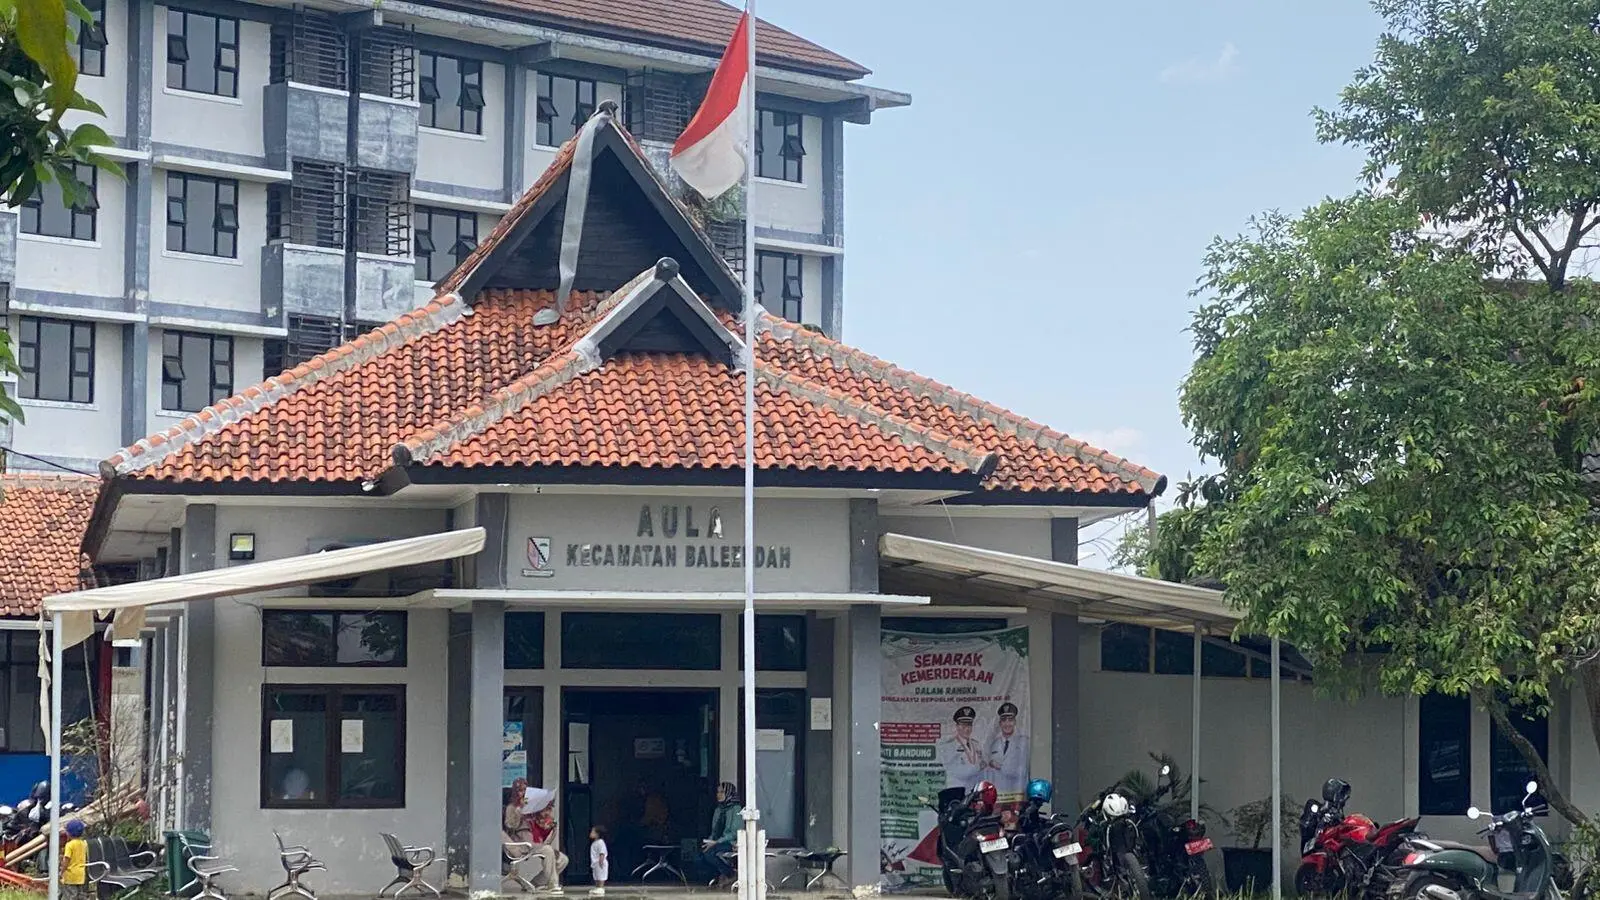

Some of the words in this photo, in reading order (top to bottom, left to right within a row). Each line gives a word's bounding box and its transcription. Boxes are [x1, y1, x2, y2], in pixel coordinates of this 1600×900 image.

[636, 504, 725, 539] AULA
[566, 543, 677, 568] KECAMATAN
[685, 544, 791, 569] BALEEDAH
[914, 652, 984, 668] SEMARAK
[900, 668, 994, 686] KEMERDEKAAN
[915, 687, 943, 696] DALAM
[945, 686, 977, 695] RANGKA
[893, 747, 932, 758] BANDUNG
